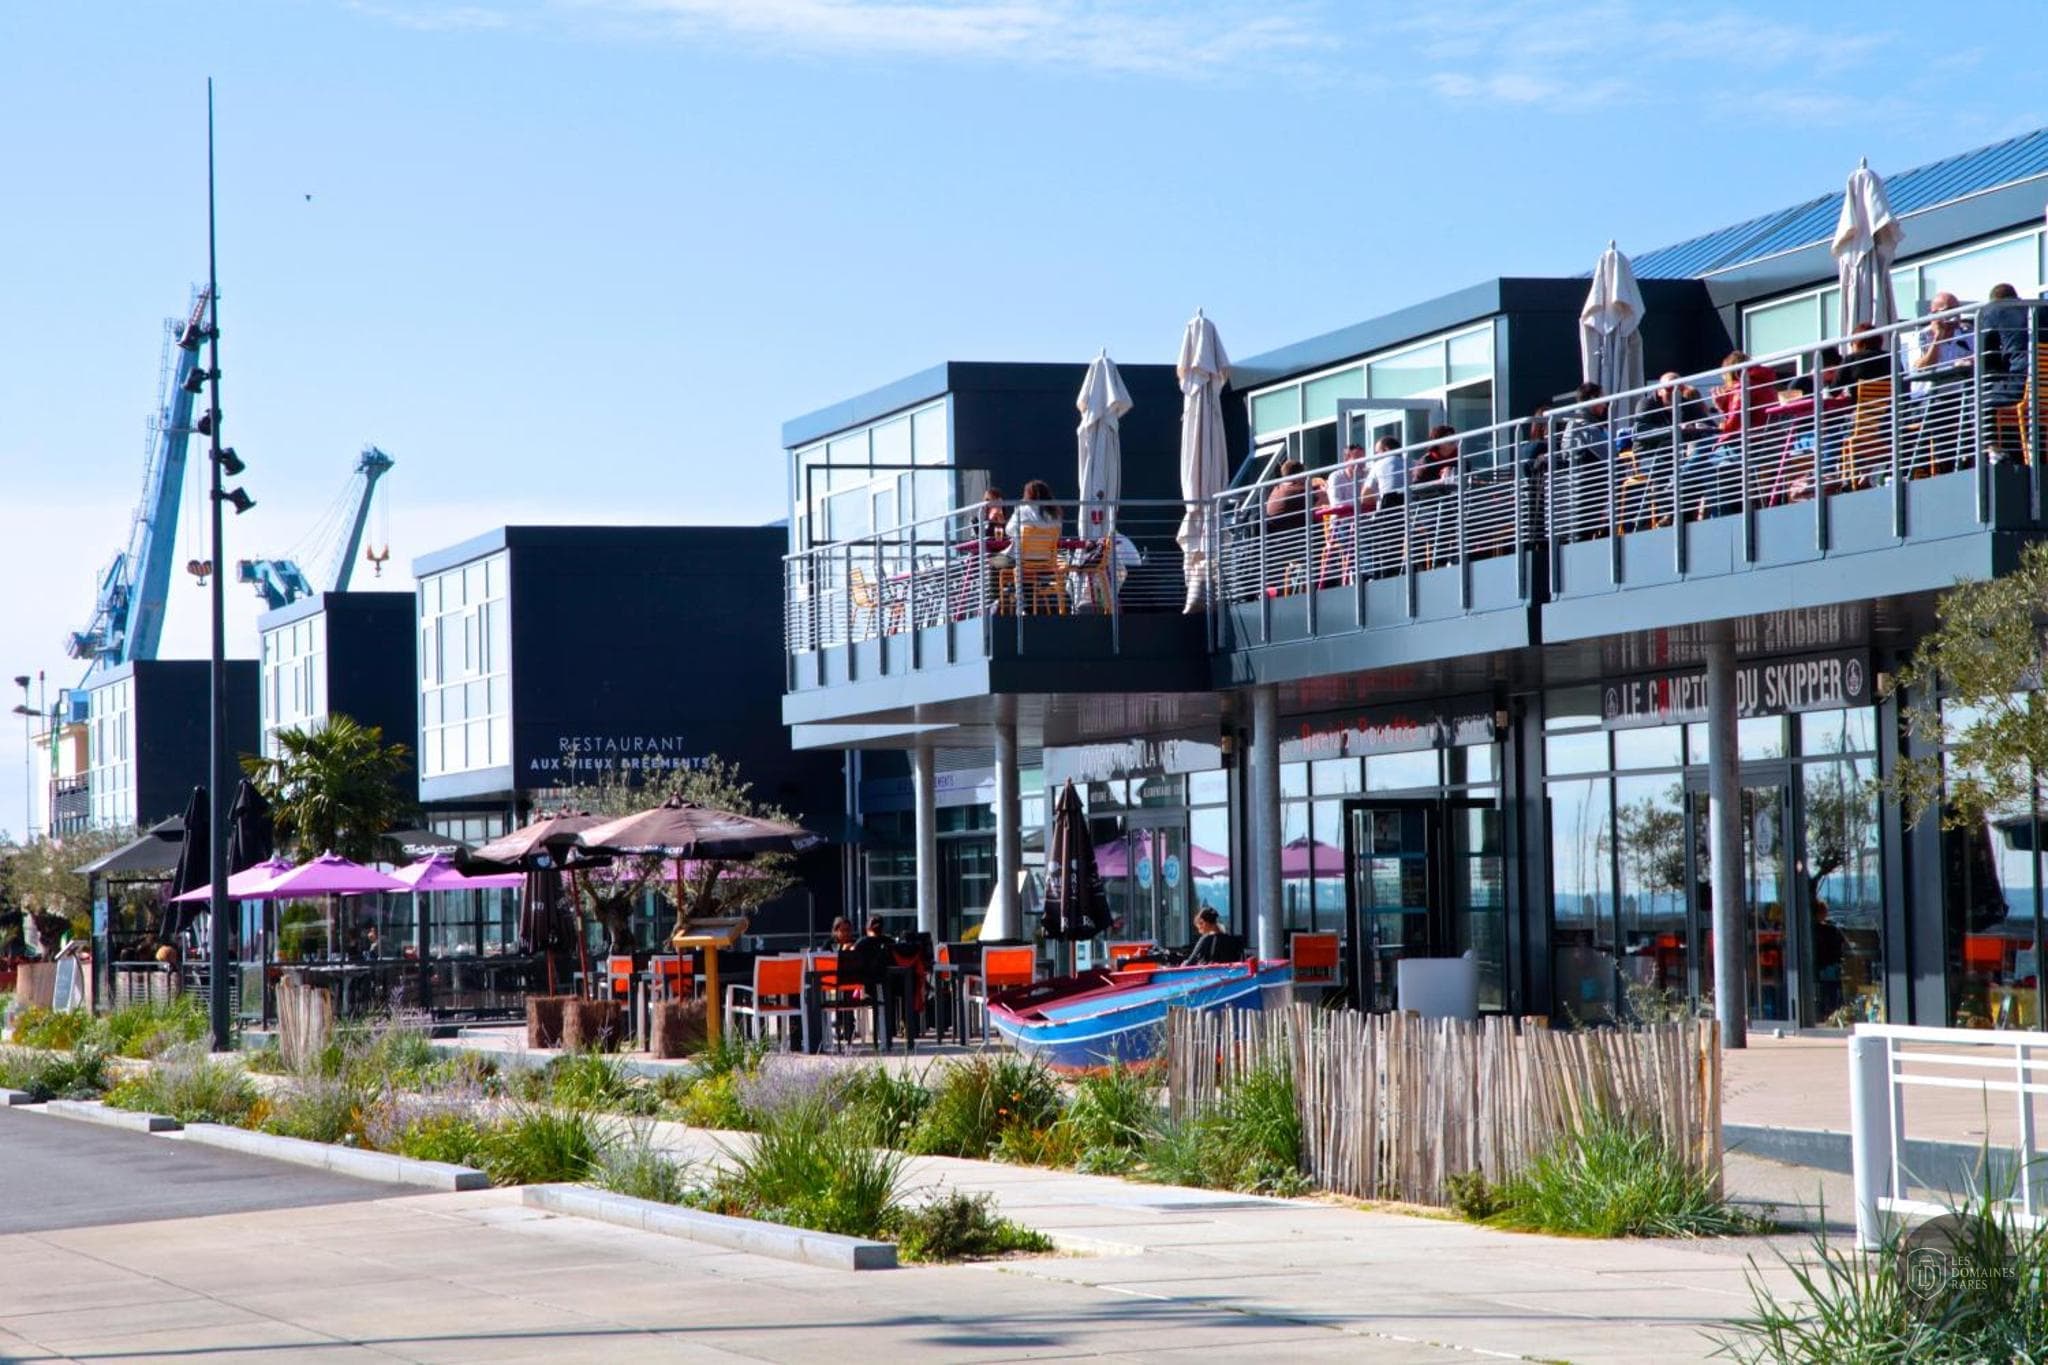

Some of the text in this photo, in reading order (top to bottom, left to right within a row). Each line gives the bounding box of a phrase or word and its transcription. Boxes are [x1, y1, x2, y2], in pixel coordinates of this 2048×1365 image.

[1621, 658, 1843, 721] LE COMPTO DU SKIPPER
[559, 736, 684, 752] RESTAURANT
[530, 758, 560, 770] AUX
[566, 757, 612, 770] VIEUX
